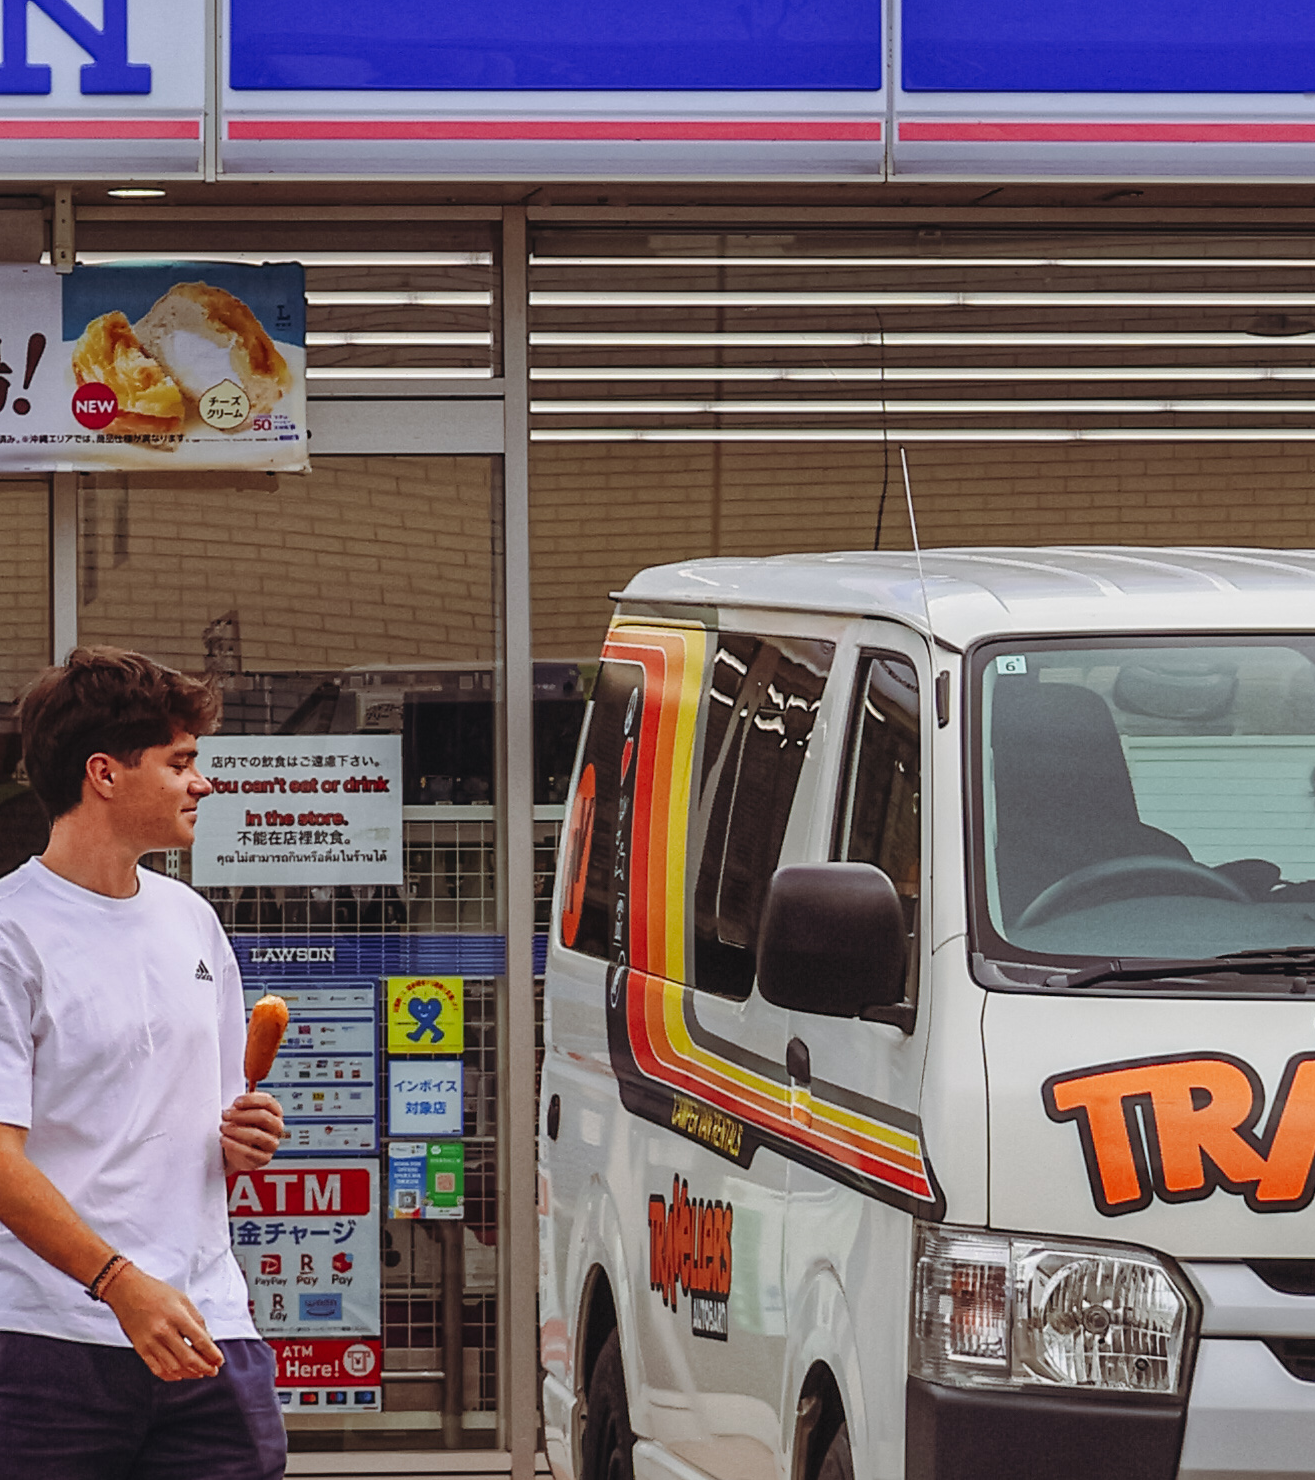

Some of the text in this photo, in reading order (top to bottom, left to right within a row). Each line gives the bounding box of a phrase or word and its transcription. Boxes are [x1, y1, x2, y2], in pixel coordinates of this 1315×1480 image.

[75, 400, 115, 413] NEW
[208, 396, 242, 406] チーズ
[206, 409, 244, 419] クリーム
[1005, 661, 1016, 672] 6
[211, 755, 380, 768] 店内での飲食はご遠慮下さい。
[205, 776, 390, 794] You can't eat or drink
[245, 810, 349, 827] in the store.
[237, 831, 351, 846] 不能在店裡飲食。
[249, 947, 336, 962] LAWSON
[393, 1080, 458, 1093] インボイス
[405, 1101, 447, 1115] 対象店
[228, 1173, 342, 1212] ATM
[230, 1219, 357, 1246] 金チャージ
[254, 1276, 288, 1287] PayPay
[296, 1276, 319, 1287] Pay
[331, 1274, 353, 1287] Pay
[282, 1345, 313, 1358] ATM
[286, 1359, 340, 1378] Here!
